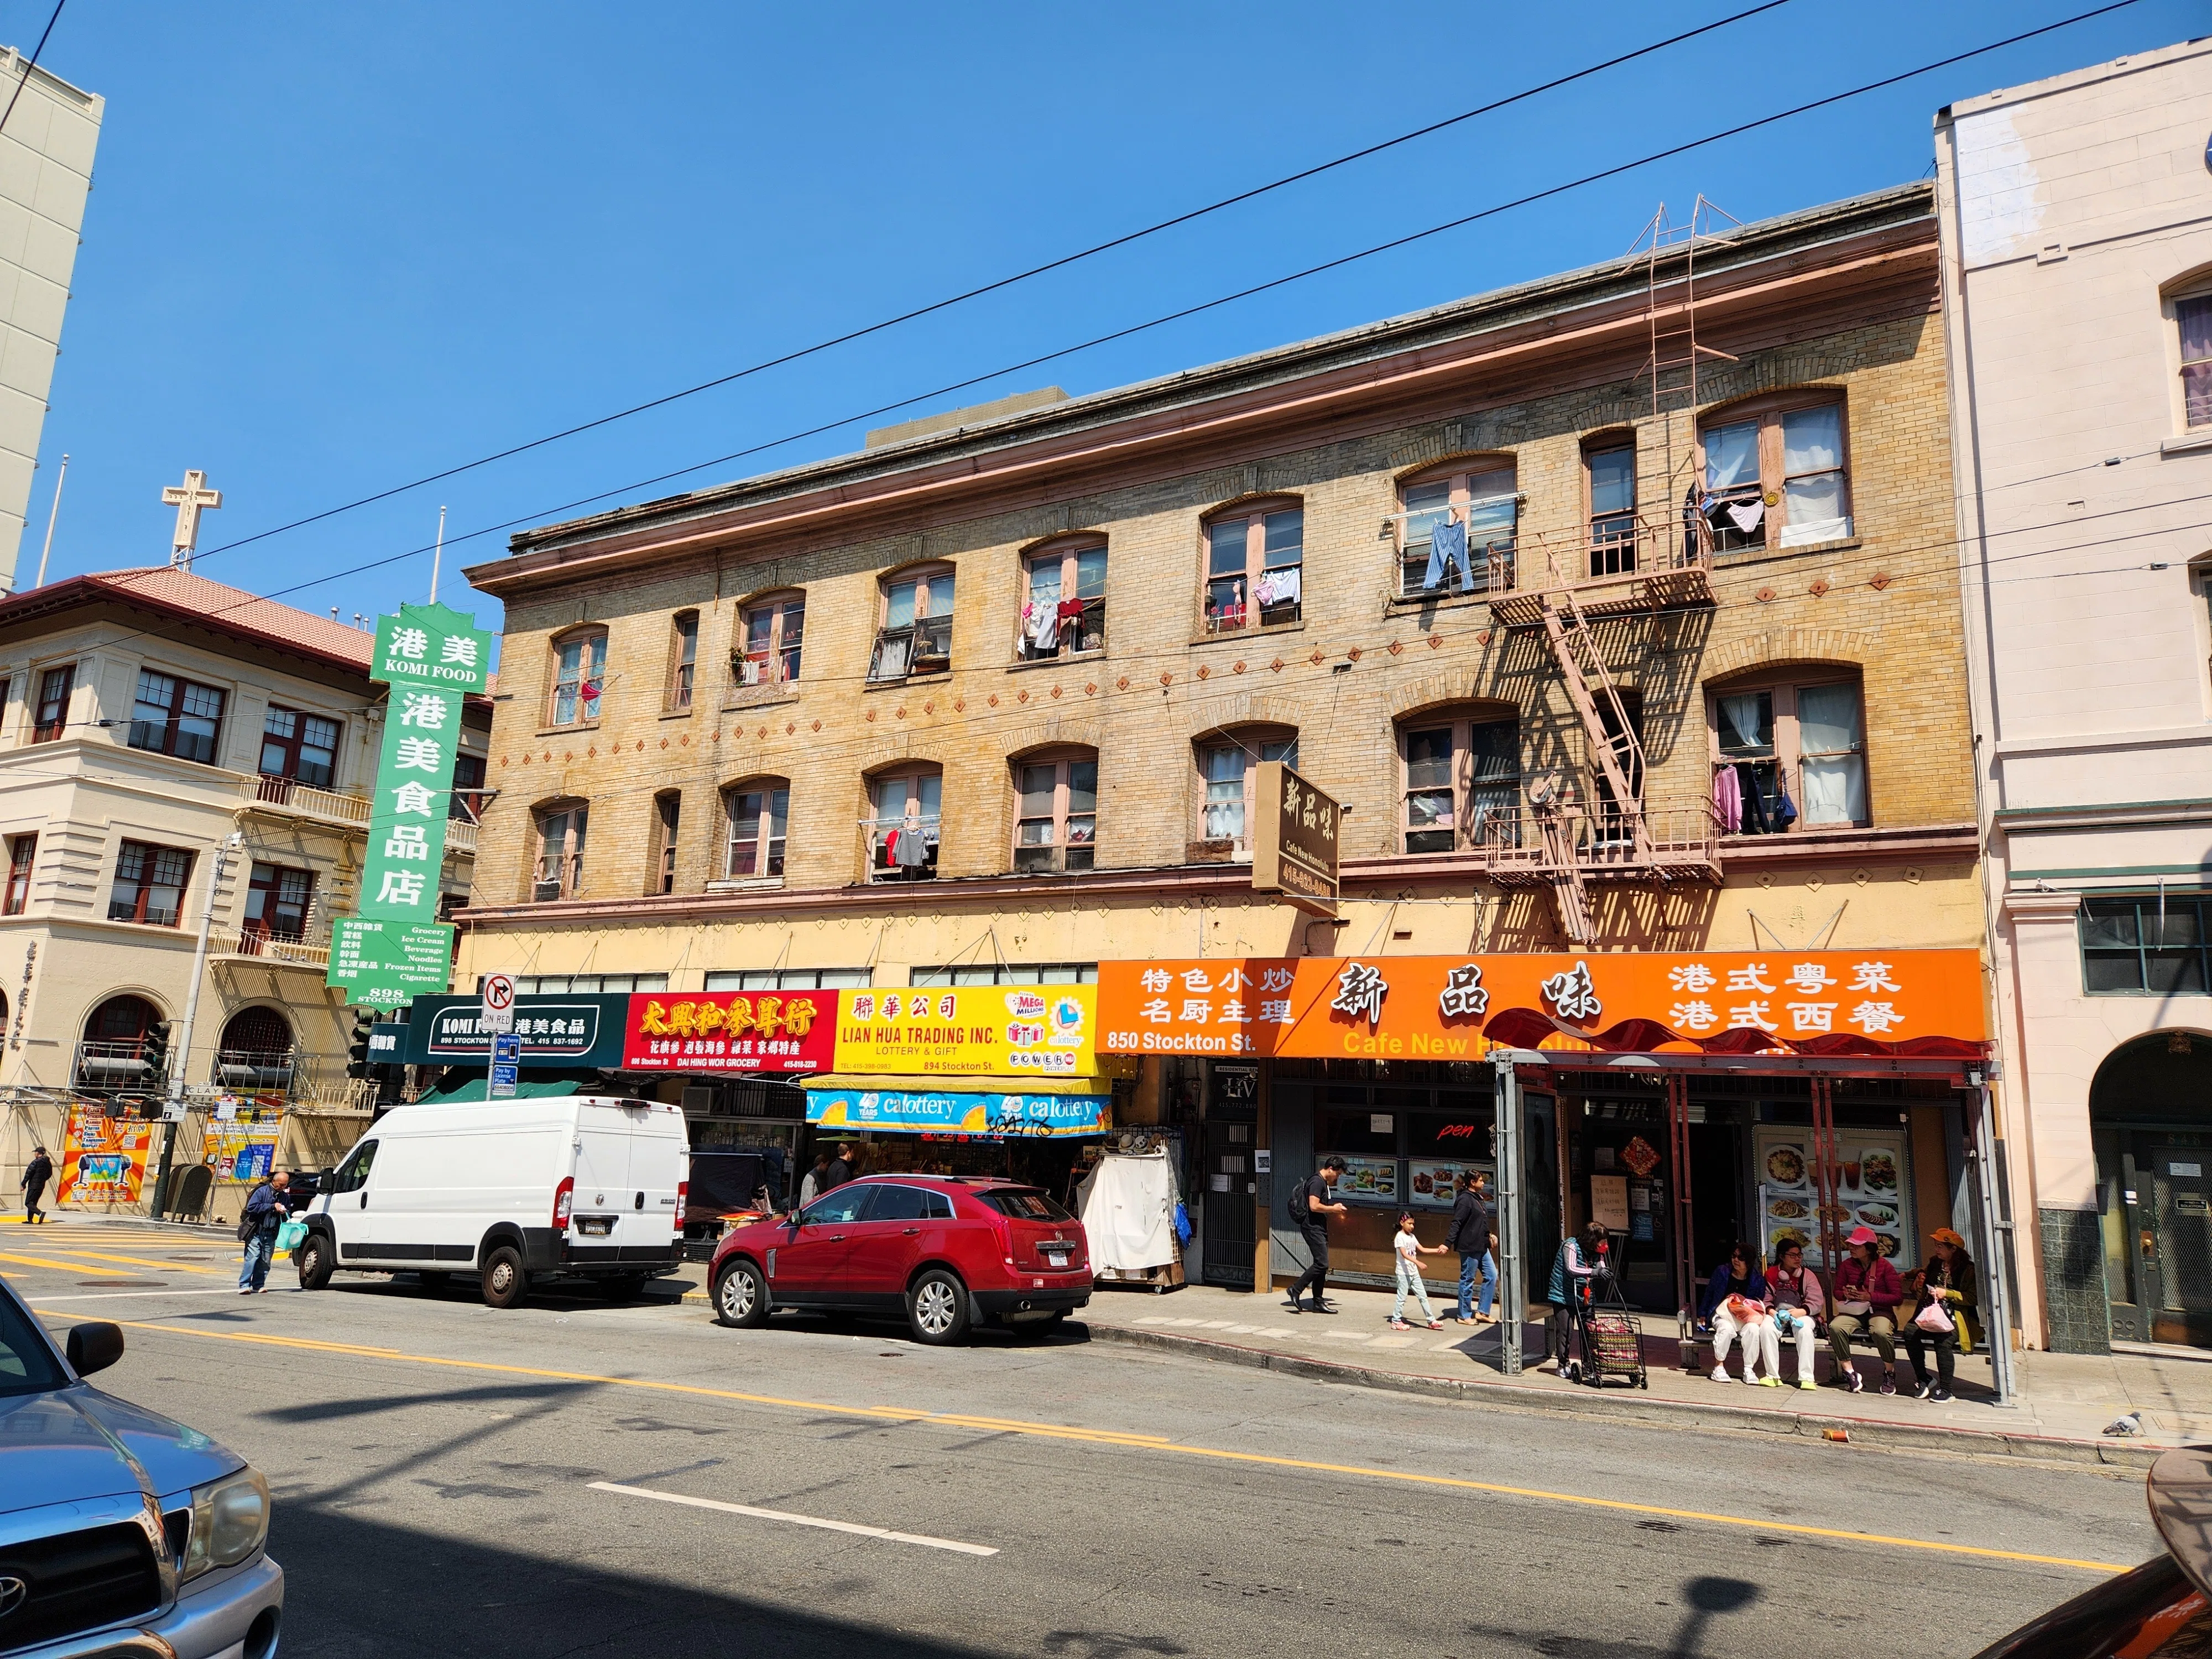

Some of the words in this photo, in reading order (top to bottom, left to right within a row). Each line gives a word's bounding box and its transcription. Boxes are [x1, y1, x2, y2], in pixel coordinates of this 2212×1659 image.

[389, 626, 478, 667] 港美
[384, 659, 429, 676] KOMI
[431, 665, 477, 682] FOOD
[375, 692, 447, 906] 港美食品店
[1284, 775, 1334, 841] 新品味
[1286, 839, 1297, 855] Cafe
[1298, 846, 1308, 859] New
[1308, 852, 1329, 872] Honolulu
[342, 931, 362, 940] 雪糕
[412, 927, 446, 936] Grocery
[341, 941, 361, 950] 飲料
[404, 946, 444, 954] Beverage
[408, 955, 442, 963] Noodles
[384, 963, 415, 972] Frozen
[399, 973, 440, 982] Cigarette
[1140, 967, 1295, 993] 特色小炒
[369, 988, 404, 999] 898
[1331, 961, 1602, 1024] 新品味
[358, 996, 413, 1005] STOCKTON
[1019, 996, 1044, 1008] MEGA
[853, 995, 957, 1021] 聯華公司
[1016, 1007, 1044, 1015] MILLIONS
[484, 1014, 494, 1023] ON
[497, 1015, 510, 1024] RED
[639, 997, 817, 1038] 大興和參茸行
[1668, 1000, 1906, 1033] 港式西餐
[441, 1018, 474, 1034] KOMI
[515, 1018, 586, 1035] 港美食品
[842, 1026, 870, 1044] LIAN
[875, 1027, 901, 1044] HUA
[907, 1027, 964, 1044] TRADING
[969, 1027, 998, 1044] INC.
[1050, 1035, 1081, 1046] calottery
[1107, 1032, 1138, 1050] 850
[1142, 1031, 1227, 1051] Stockton
[1230, 1032, 1256, 1052] St.
[1343, 1032, 1402, 1053] Cafe
[1412, 1033, 1468, 1055] New
[876, 1047, 920, 1055] LOTTERY
[935, 1047, 958, 1056] GIFT
[641, 1057, 661, 1066] Stockton
[677, 1058, 689, 1067] DAI
[690, 1058, 707, 1067] HING
[708, 1058, 725, 1067] WOR
[726, 1058, 761, 1067] GROCERY
[784, 1060, 817, 1068] 415-818-2230
[924, 1062, 940, 1071] 894
[942, 1061, 982, 1071] Stockton
[983, 1062, 994, 1071] St.
[884, 1094, 956, 1120] calottery
[1029, 1097, 1093, 1120] calottery
